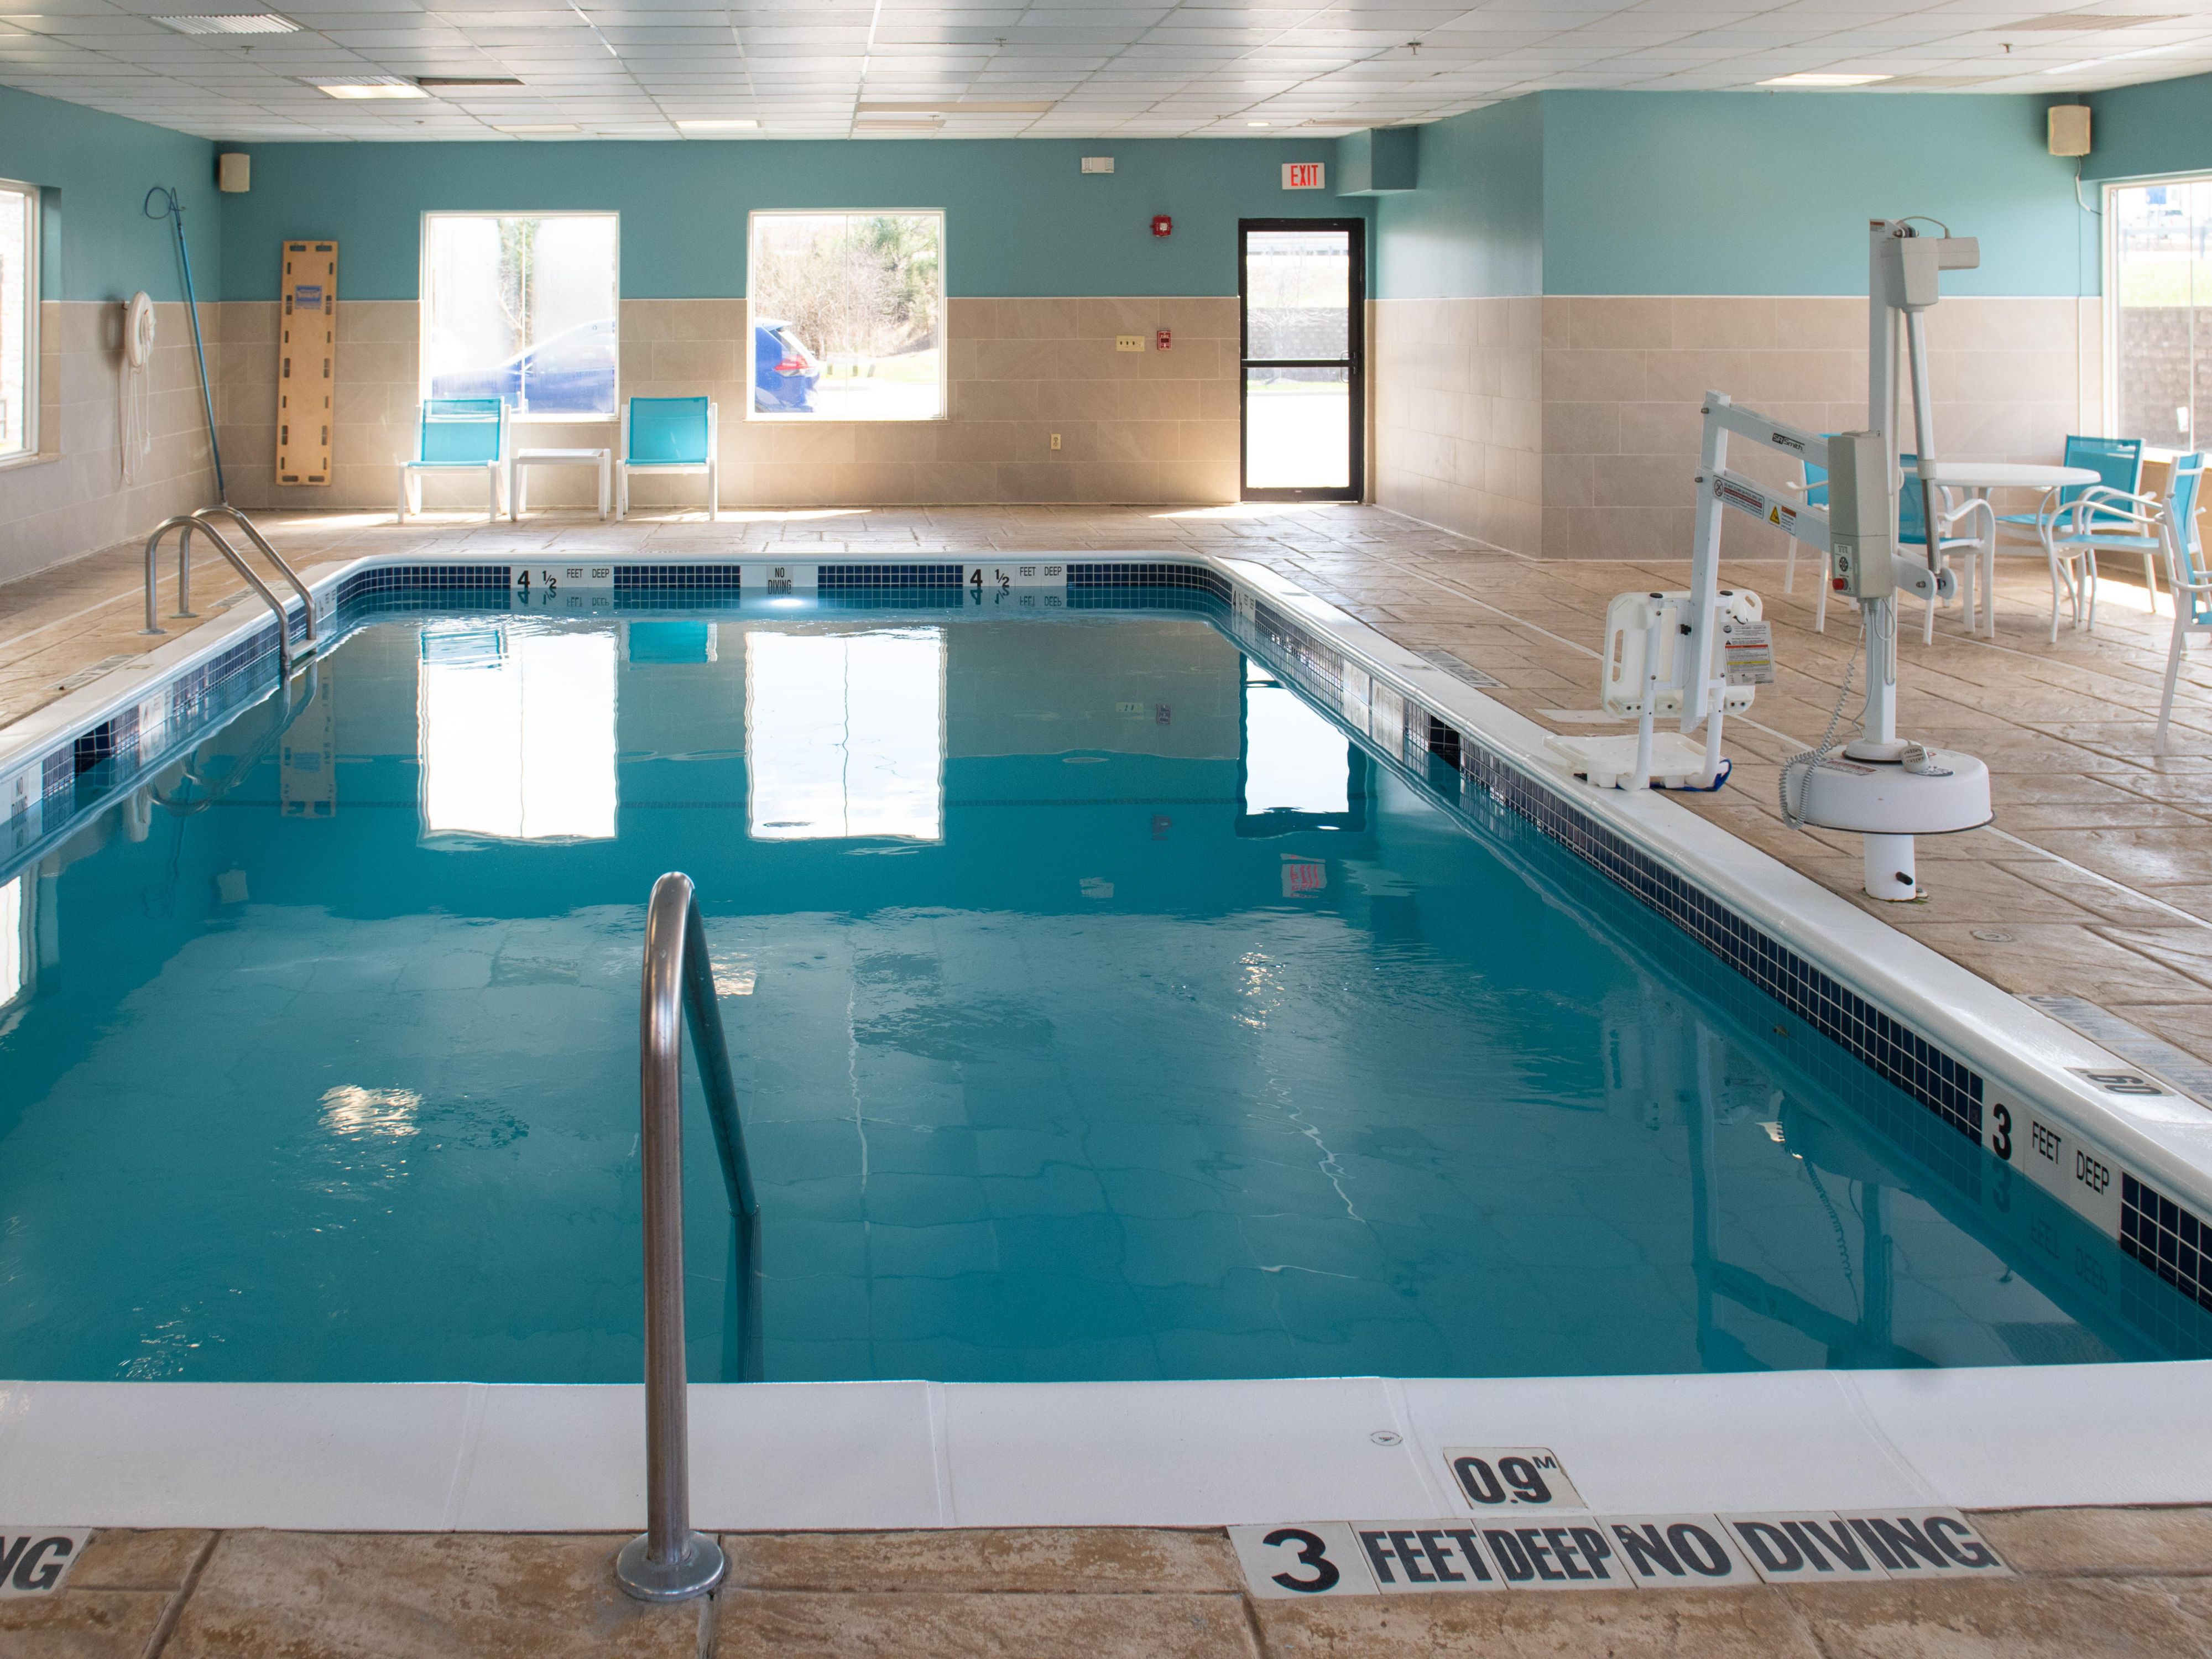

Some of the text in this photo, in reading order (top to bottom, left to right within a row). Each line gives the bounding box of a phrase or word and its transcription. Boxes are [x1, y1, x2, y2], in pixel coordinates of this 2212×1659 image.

[1291, 165, 1318, 186] EXIT
[518, 570, 530, 588] 4
[567, 568, 583, 578] FEET
[592, 568, 609, 578] DEEP
[775, 567, 785, 578] NO
[970, 569, 983, 587] 4
[1020, 567, 1036, 576] FEET
[1045, 566, 1062, 576] DEEP
[1233, 590, 1237, 611] 4
[16, 776, 23, 797] NO
[1993, 1103, 2110, 1196] 3 FEET DEEP
[1262, 1517, 2001, 1593] 3 FEET DEEP NO DIVING
